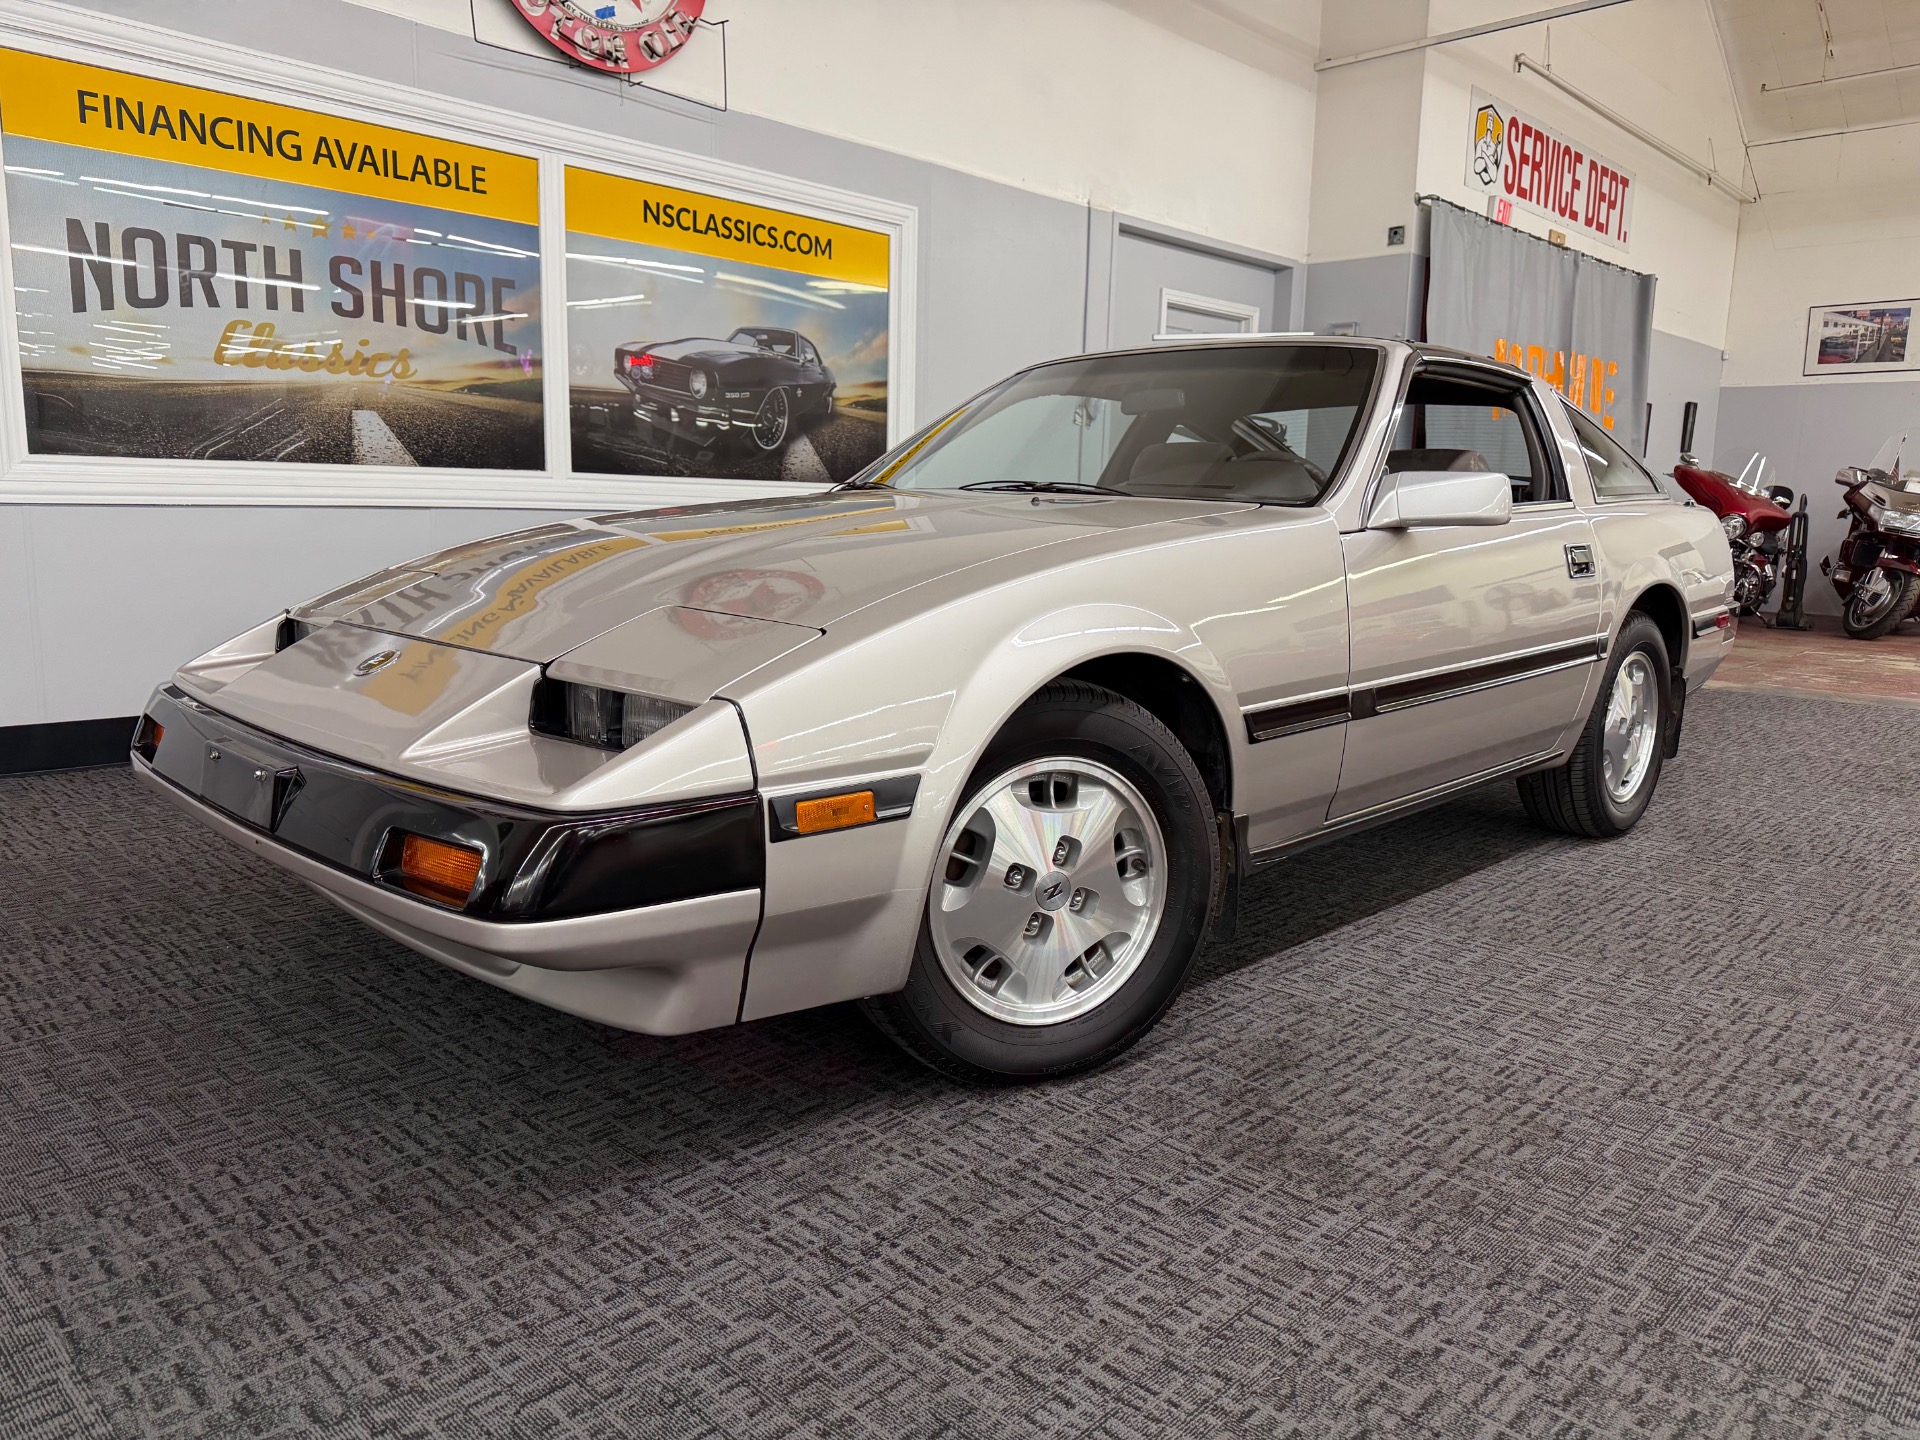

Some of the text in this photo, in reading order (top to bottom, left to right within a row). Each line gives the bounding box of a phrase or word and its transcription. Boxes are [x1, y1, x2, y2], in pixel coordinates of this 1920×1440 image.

[579, 12, 593, 24] THE
[596, 20, 618, 31] TEXAS
[77, 89, 487, 195] FINANCING AVAILABLE
[1504, 115, 1629, 243] SERVICE DEPT.
[642, 199, 832, 260] NSCLASSICS.COM
[66, 217, 517, 356] NORTH SHORE
[213, 320, 417, 380] Classics
